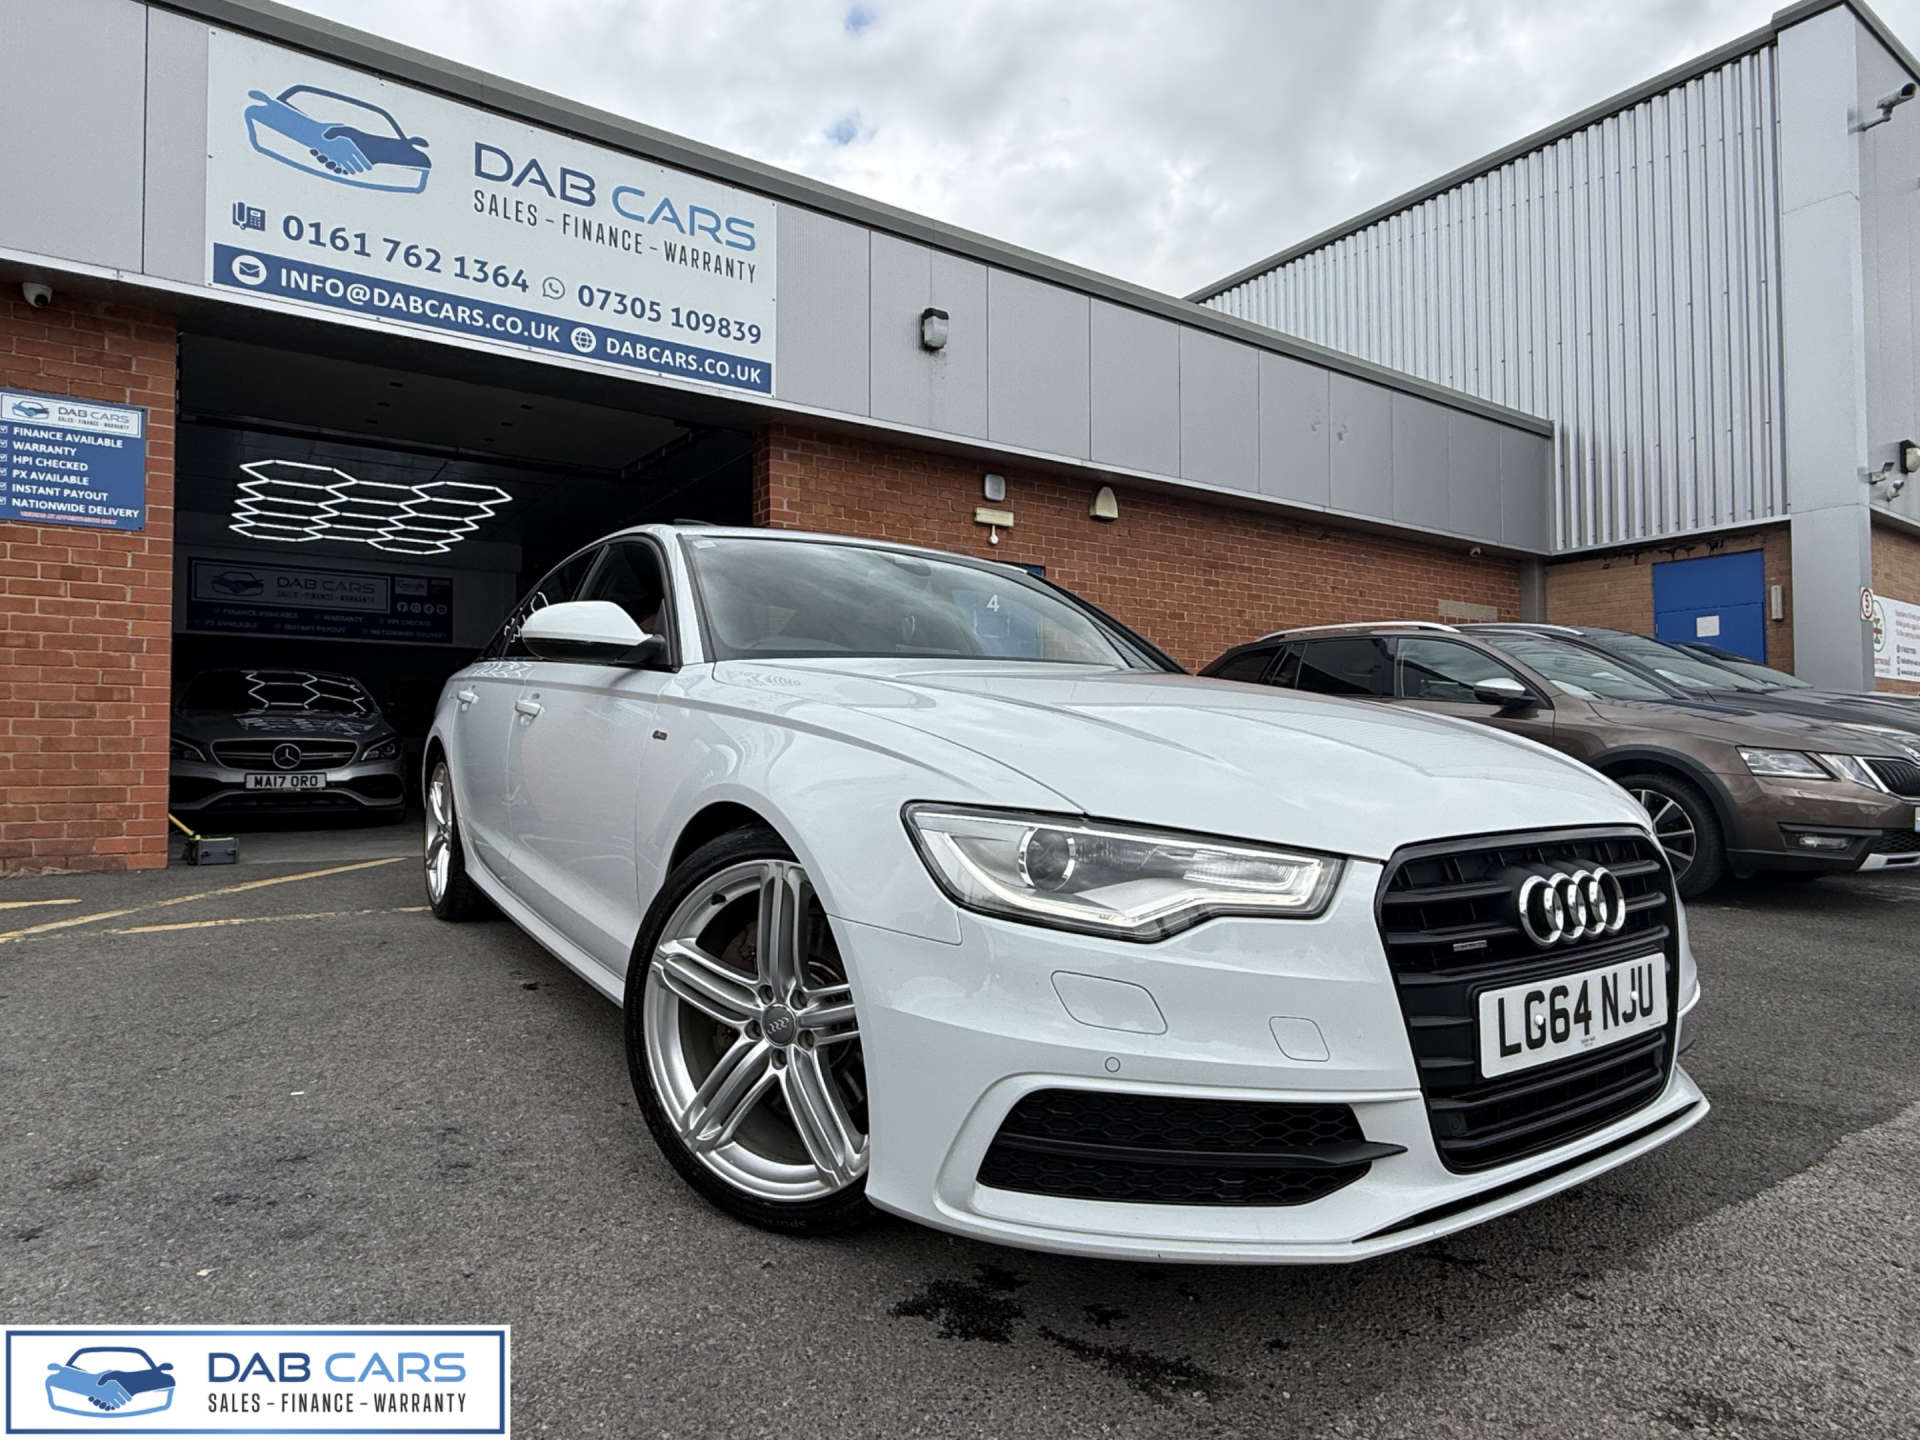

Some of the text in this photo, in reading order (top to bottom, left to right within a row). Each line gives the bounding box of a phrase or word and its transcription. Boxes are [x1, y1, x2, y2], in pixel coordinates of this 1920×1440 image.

[475, 142, 756, 251] DAB CARS
[474, 190, 538, 226] SALES
[563, 214, 643, 254] FINANCE
[664, 241, 756, 283] WARRANTY
[282, 215, 529, 293] 0161 762 1364
[280, 268, 560, 343] INFO@DABCARS.CO.UK
[577, 284, 761, 344] 07305 109839
[606, 337, 761, 384] DABCARS.CO.UK
[58, 407, 129, 423] DAB CARS
[13, 427, 123, 448] FINANCE AVAILABLE
[13, 441, 76, 456] WARRANTY
[13, 455, 88, 471] HPI CHECKED
[12, 469, 89, 485] PX AVAILABLE
[12, 484, 108, 501] INSTANT PAYOUT
[12, 498, 86, 513] NATIONWIDE
[88, 505, 139, 518] DELIVERY
[277, 576, 376, 594] DAB CARS
[986, 594, 1000, 612] 4
[254, 775, 286, 787] MA17
[1497, 963, 1654, 1058] LG64 NJU
